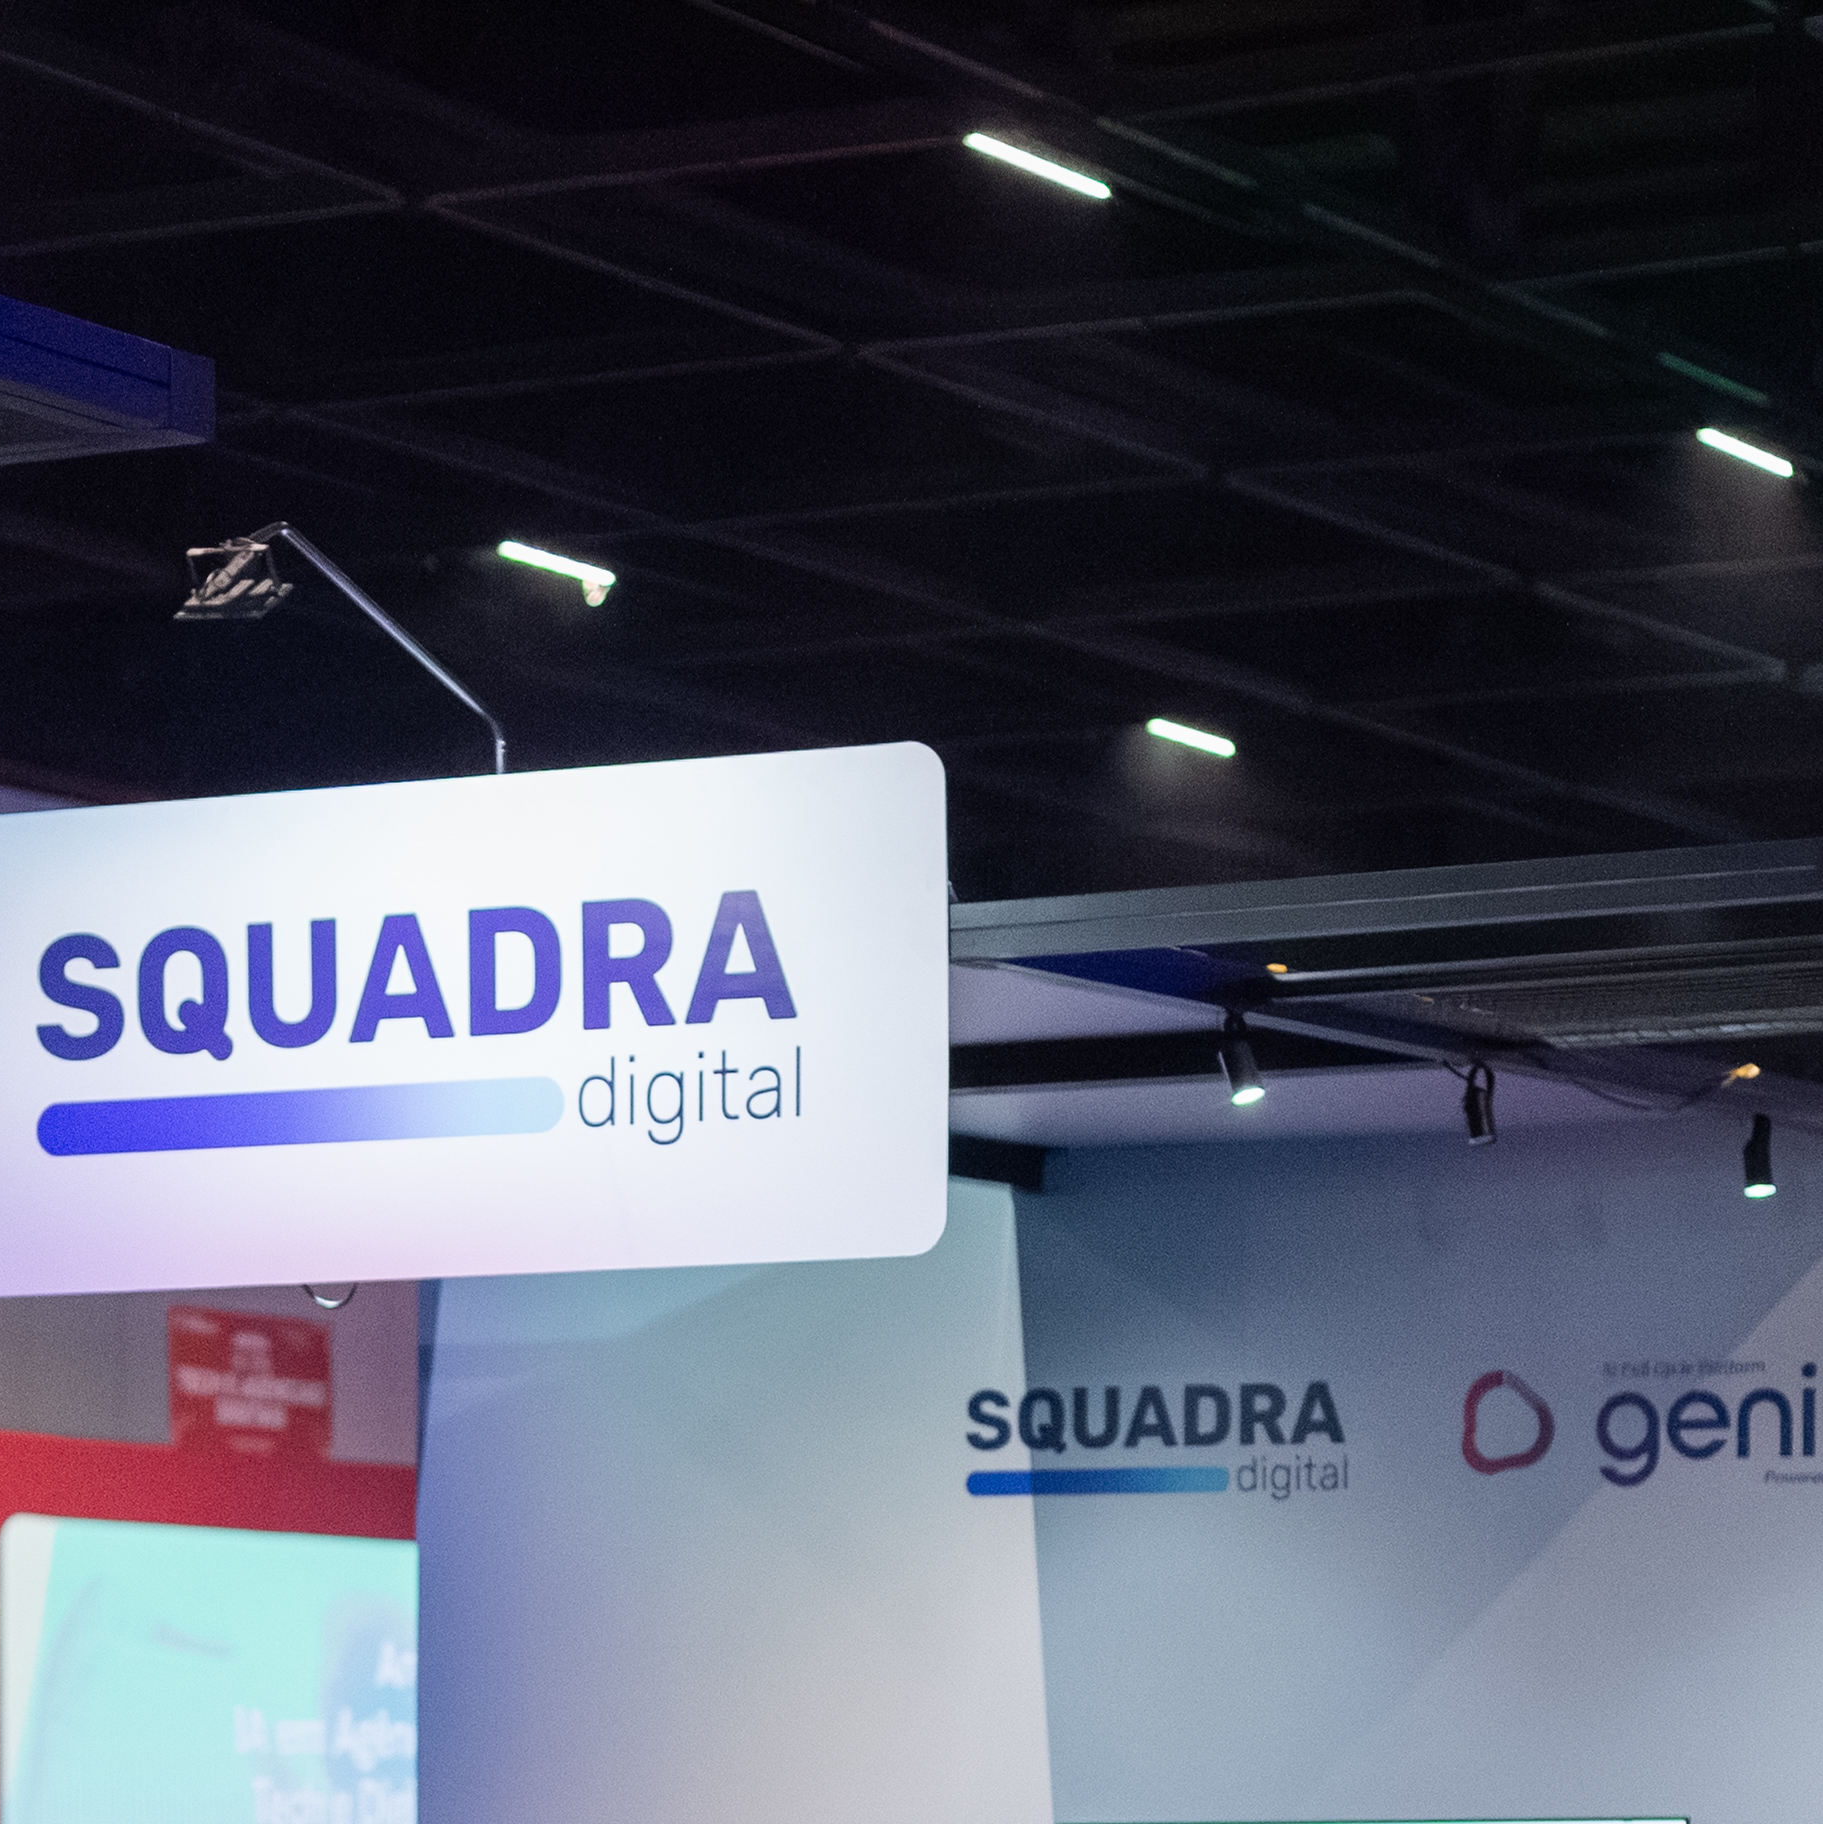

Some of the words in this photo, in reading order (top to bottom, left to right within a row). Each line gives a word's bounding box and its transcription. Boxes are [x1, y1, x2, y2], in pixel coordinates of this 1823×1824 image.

[37, 890, 797, 1060] SQUADRA
[578, 1046, 802, 1144] digital
[966, 1380, 1345, 1454] SQUADRA
[1237, 1453, 1349, 1500] digital
